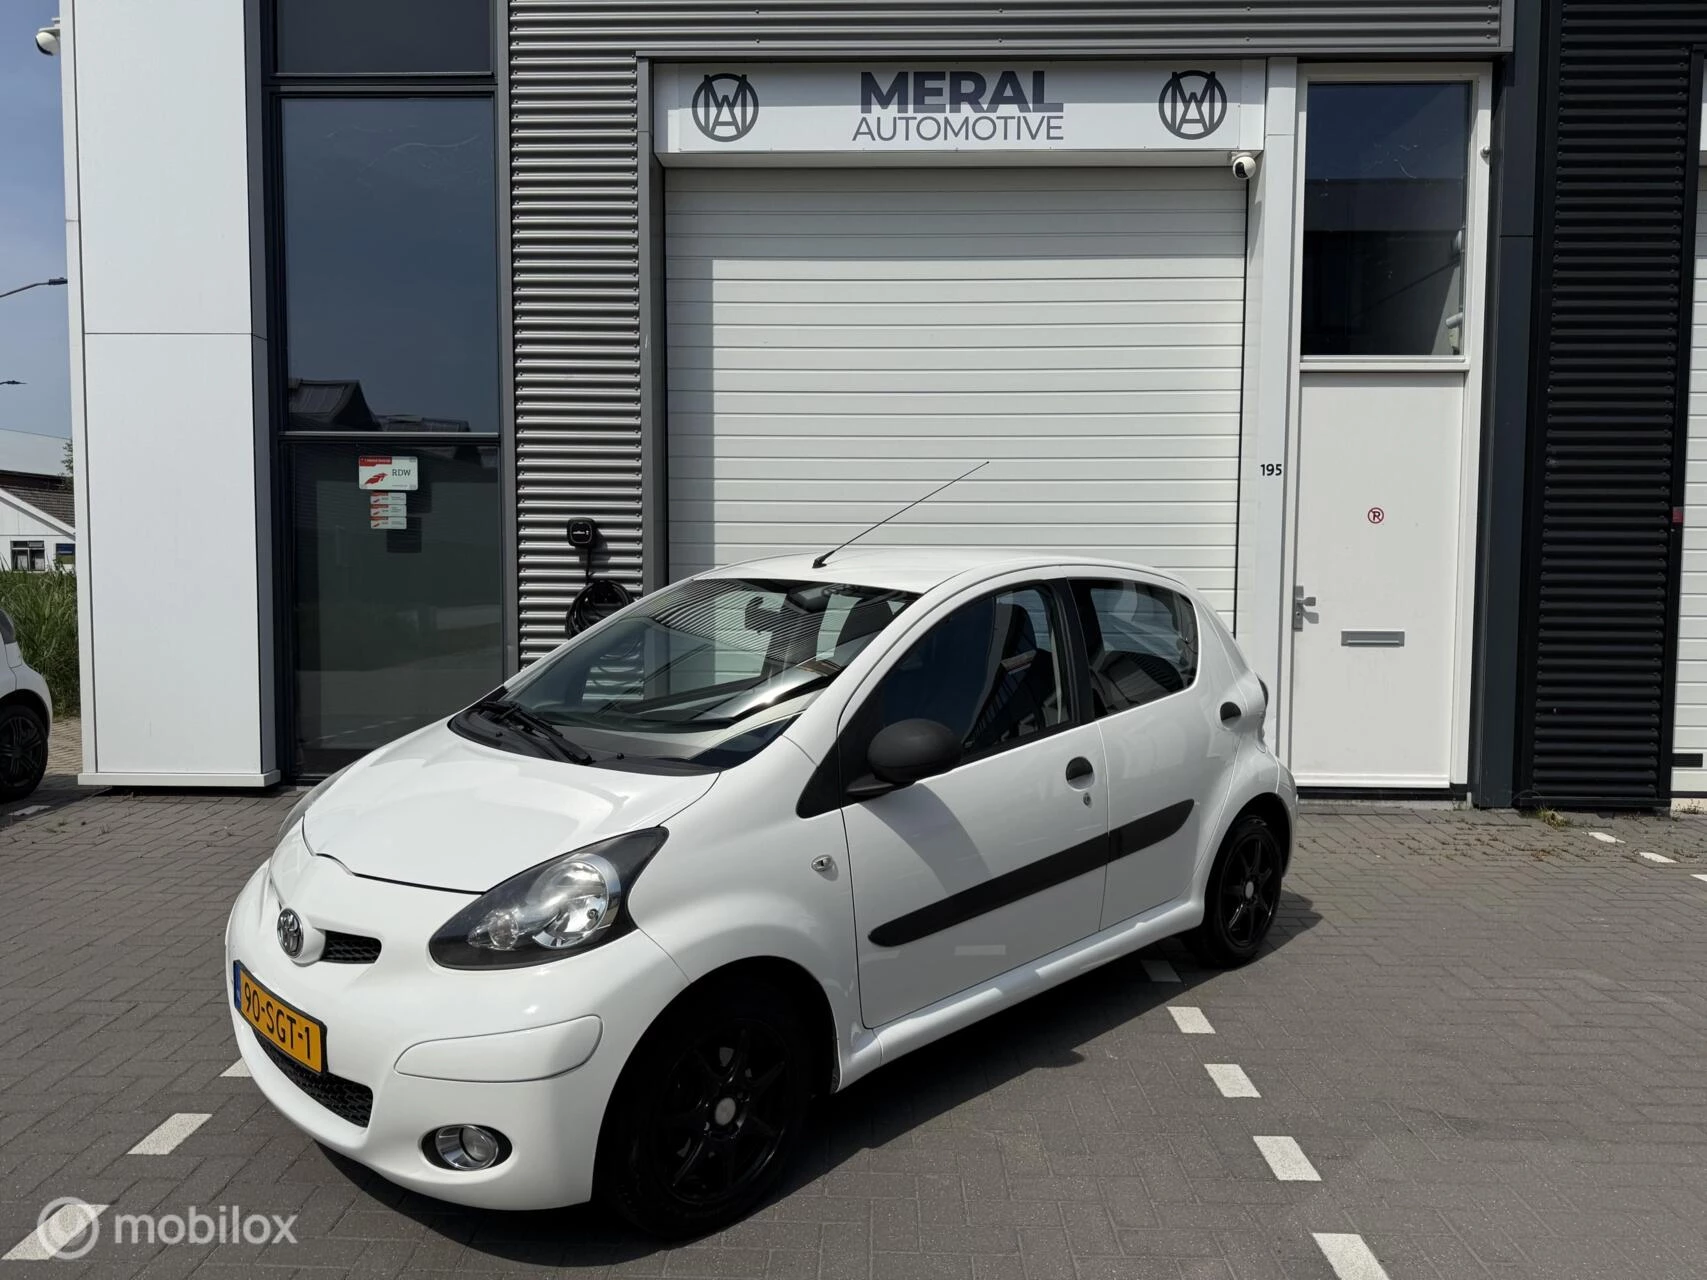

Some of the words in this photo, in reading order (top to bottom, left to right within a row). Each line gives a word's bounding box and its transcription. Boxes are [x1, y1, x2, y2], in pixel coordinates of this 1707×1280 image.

[860, 70, 1064, 114] MERAL
[852, 115, 1064, 142] AUTOMOTIVE
[391, 468, 411, 477] RDW
[1260, 463, 1282, 477] 195
[244, 981, 311, 1061] 90-SGT-1
